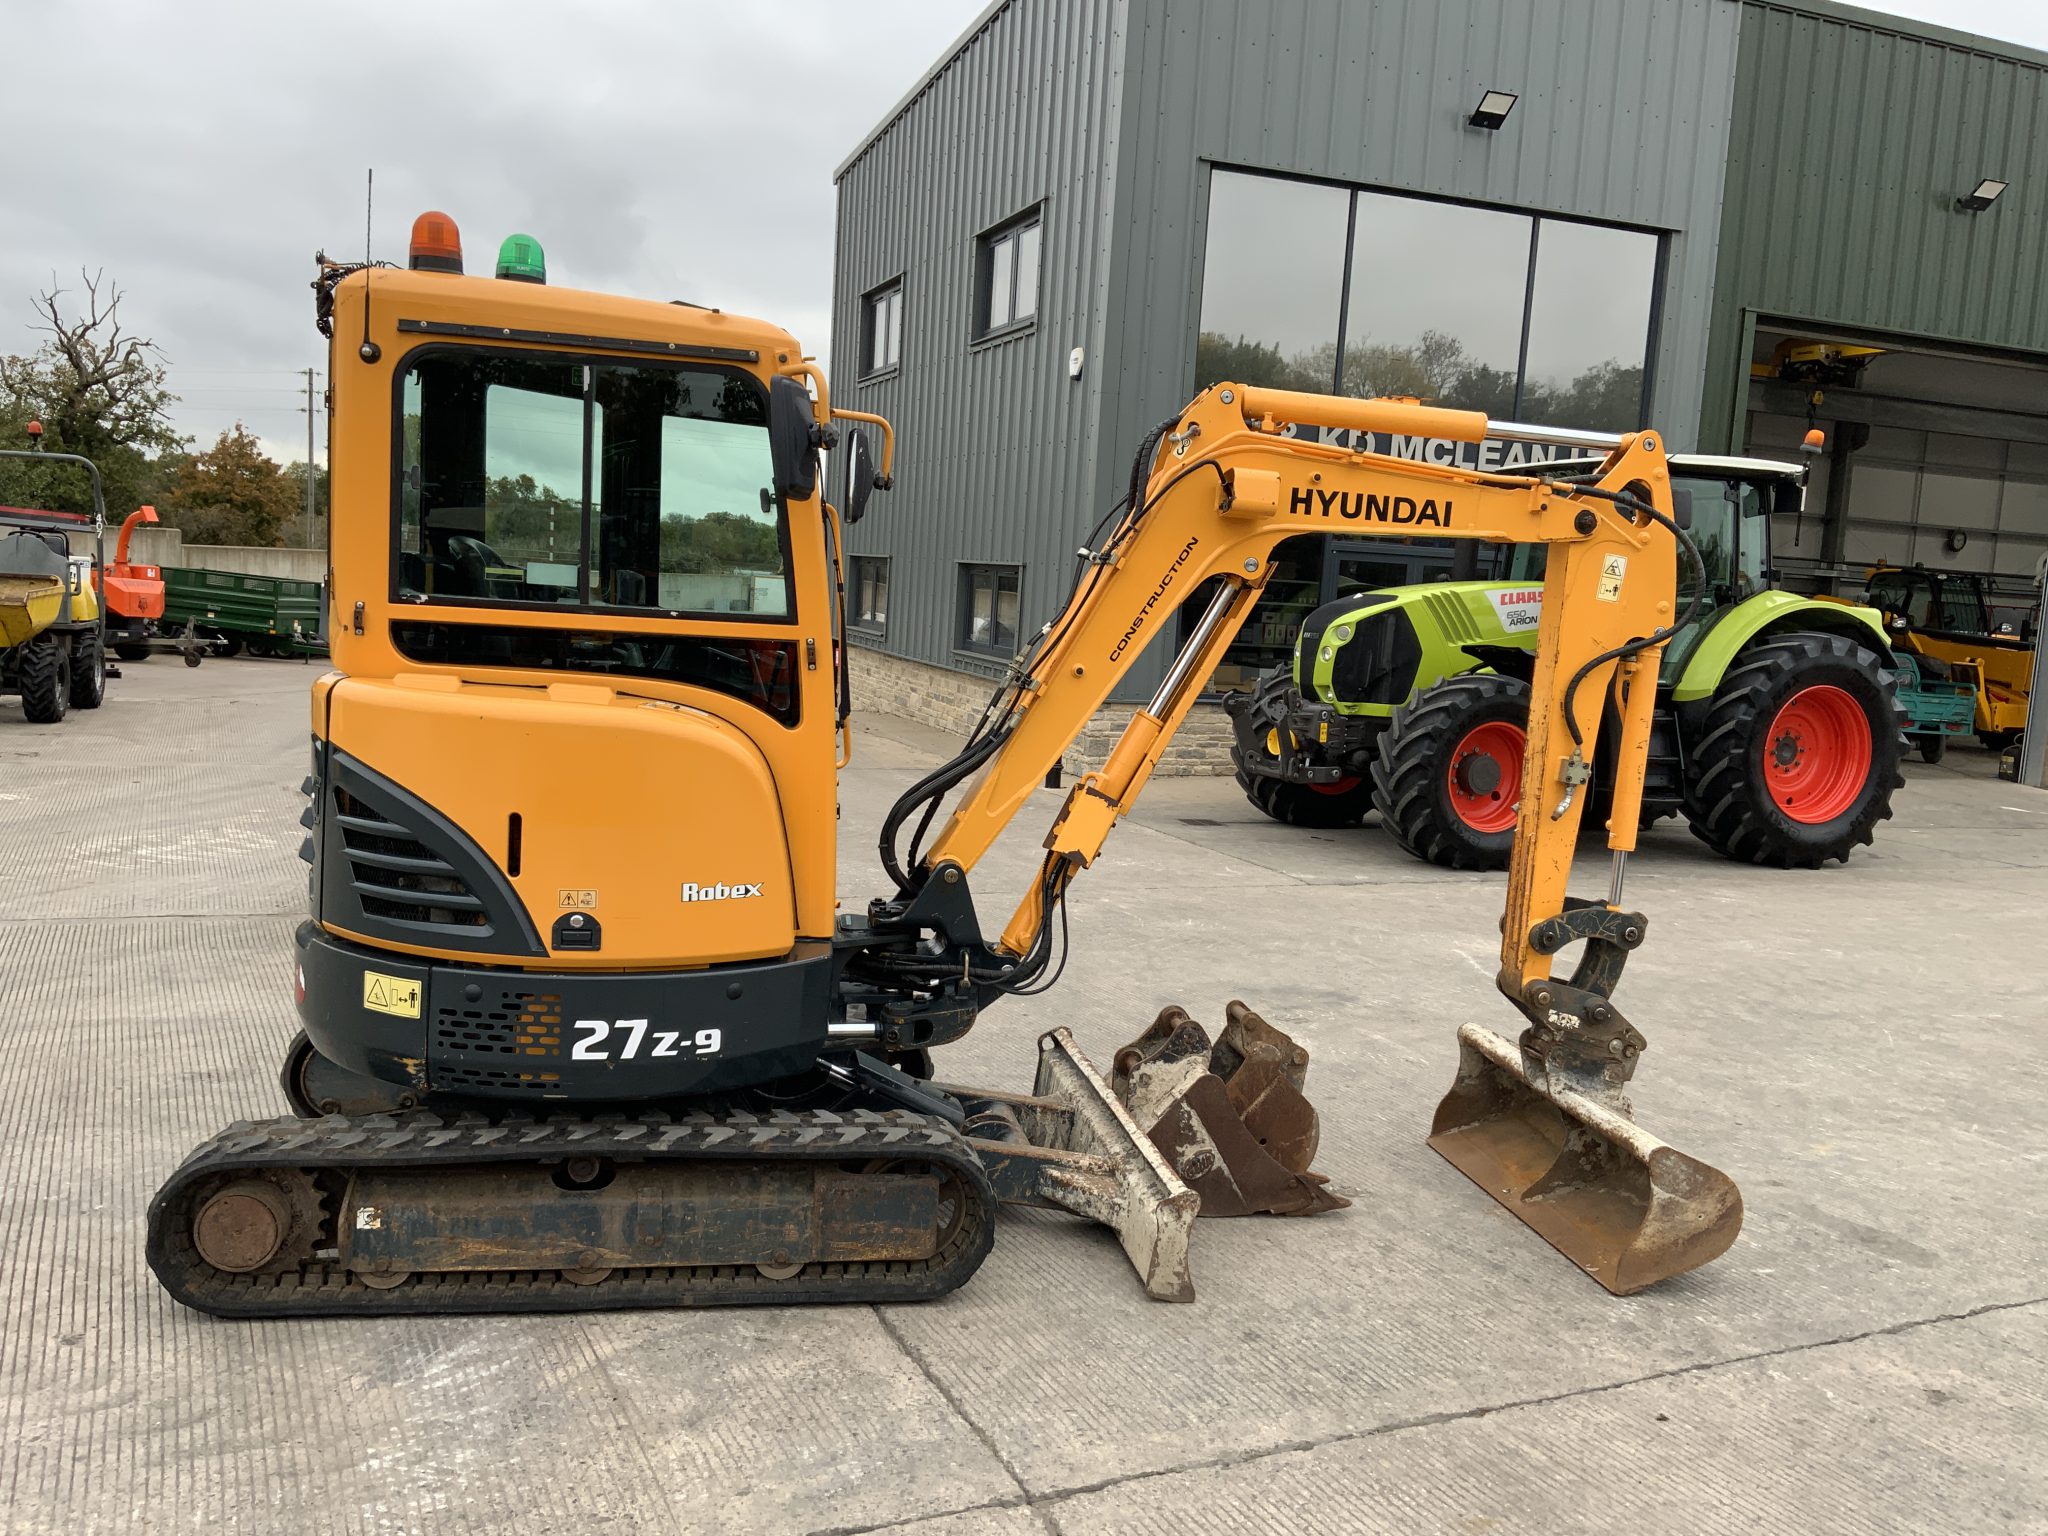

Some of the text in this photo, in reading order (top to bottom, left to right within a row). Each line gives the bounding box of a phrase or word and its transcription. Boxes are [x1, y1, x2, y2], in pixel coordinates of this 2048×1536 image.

[1289, 487, 1453, 527] HYUNDAI
[1109, 536, 1199, 662] CONSTRUCTION
[1506, 610, 1527, 620] 650
[1508, 615, 1538, 627] ARION
[681, 881, 764, 902] Robex
